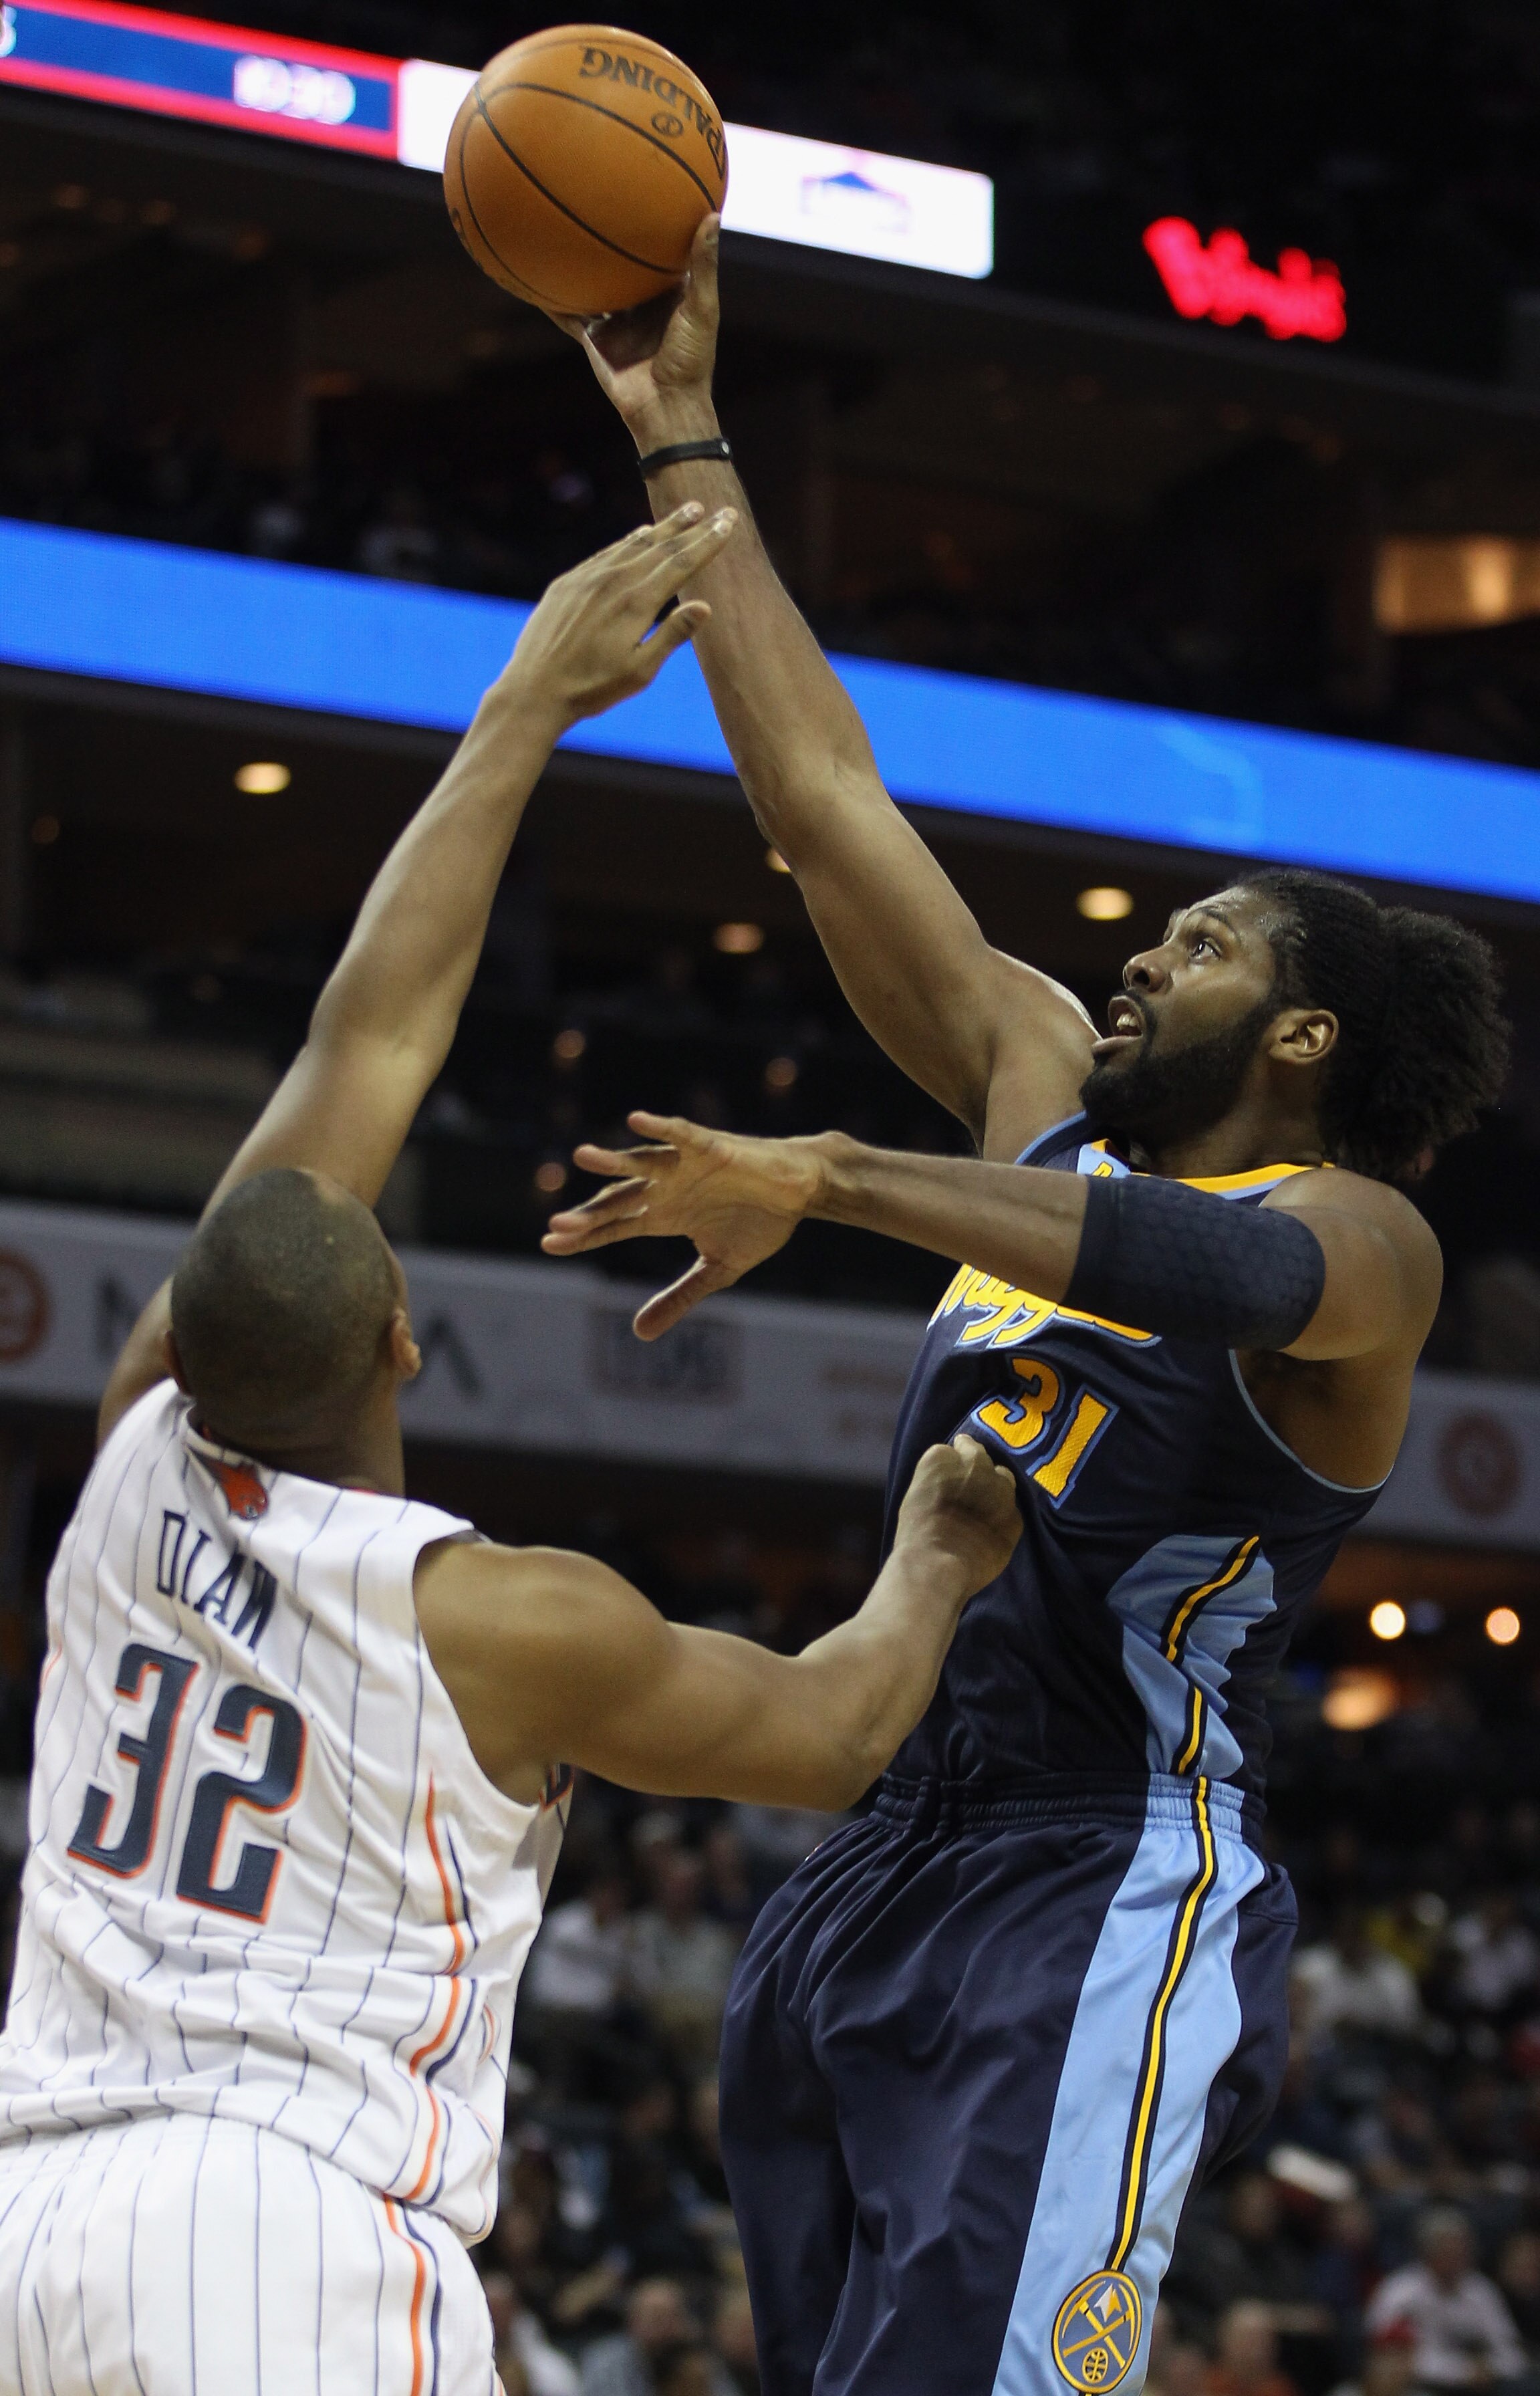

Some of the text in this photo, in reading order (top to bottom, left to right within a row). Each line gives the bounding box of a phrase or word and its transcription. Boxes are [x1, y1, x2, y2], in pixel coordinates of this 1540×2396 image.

[926, 1262, 1161, 1348] Nugg
[973, 1356, 1118, 1508] 31
[157, 1510, 278, 1653] DIAW
[67, 1642, 307, 1925] 32
